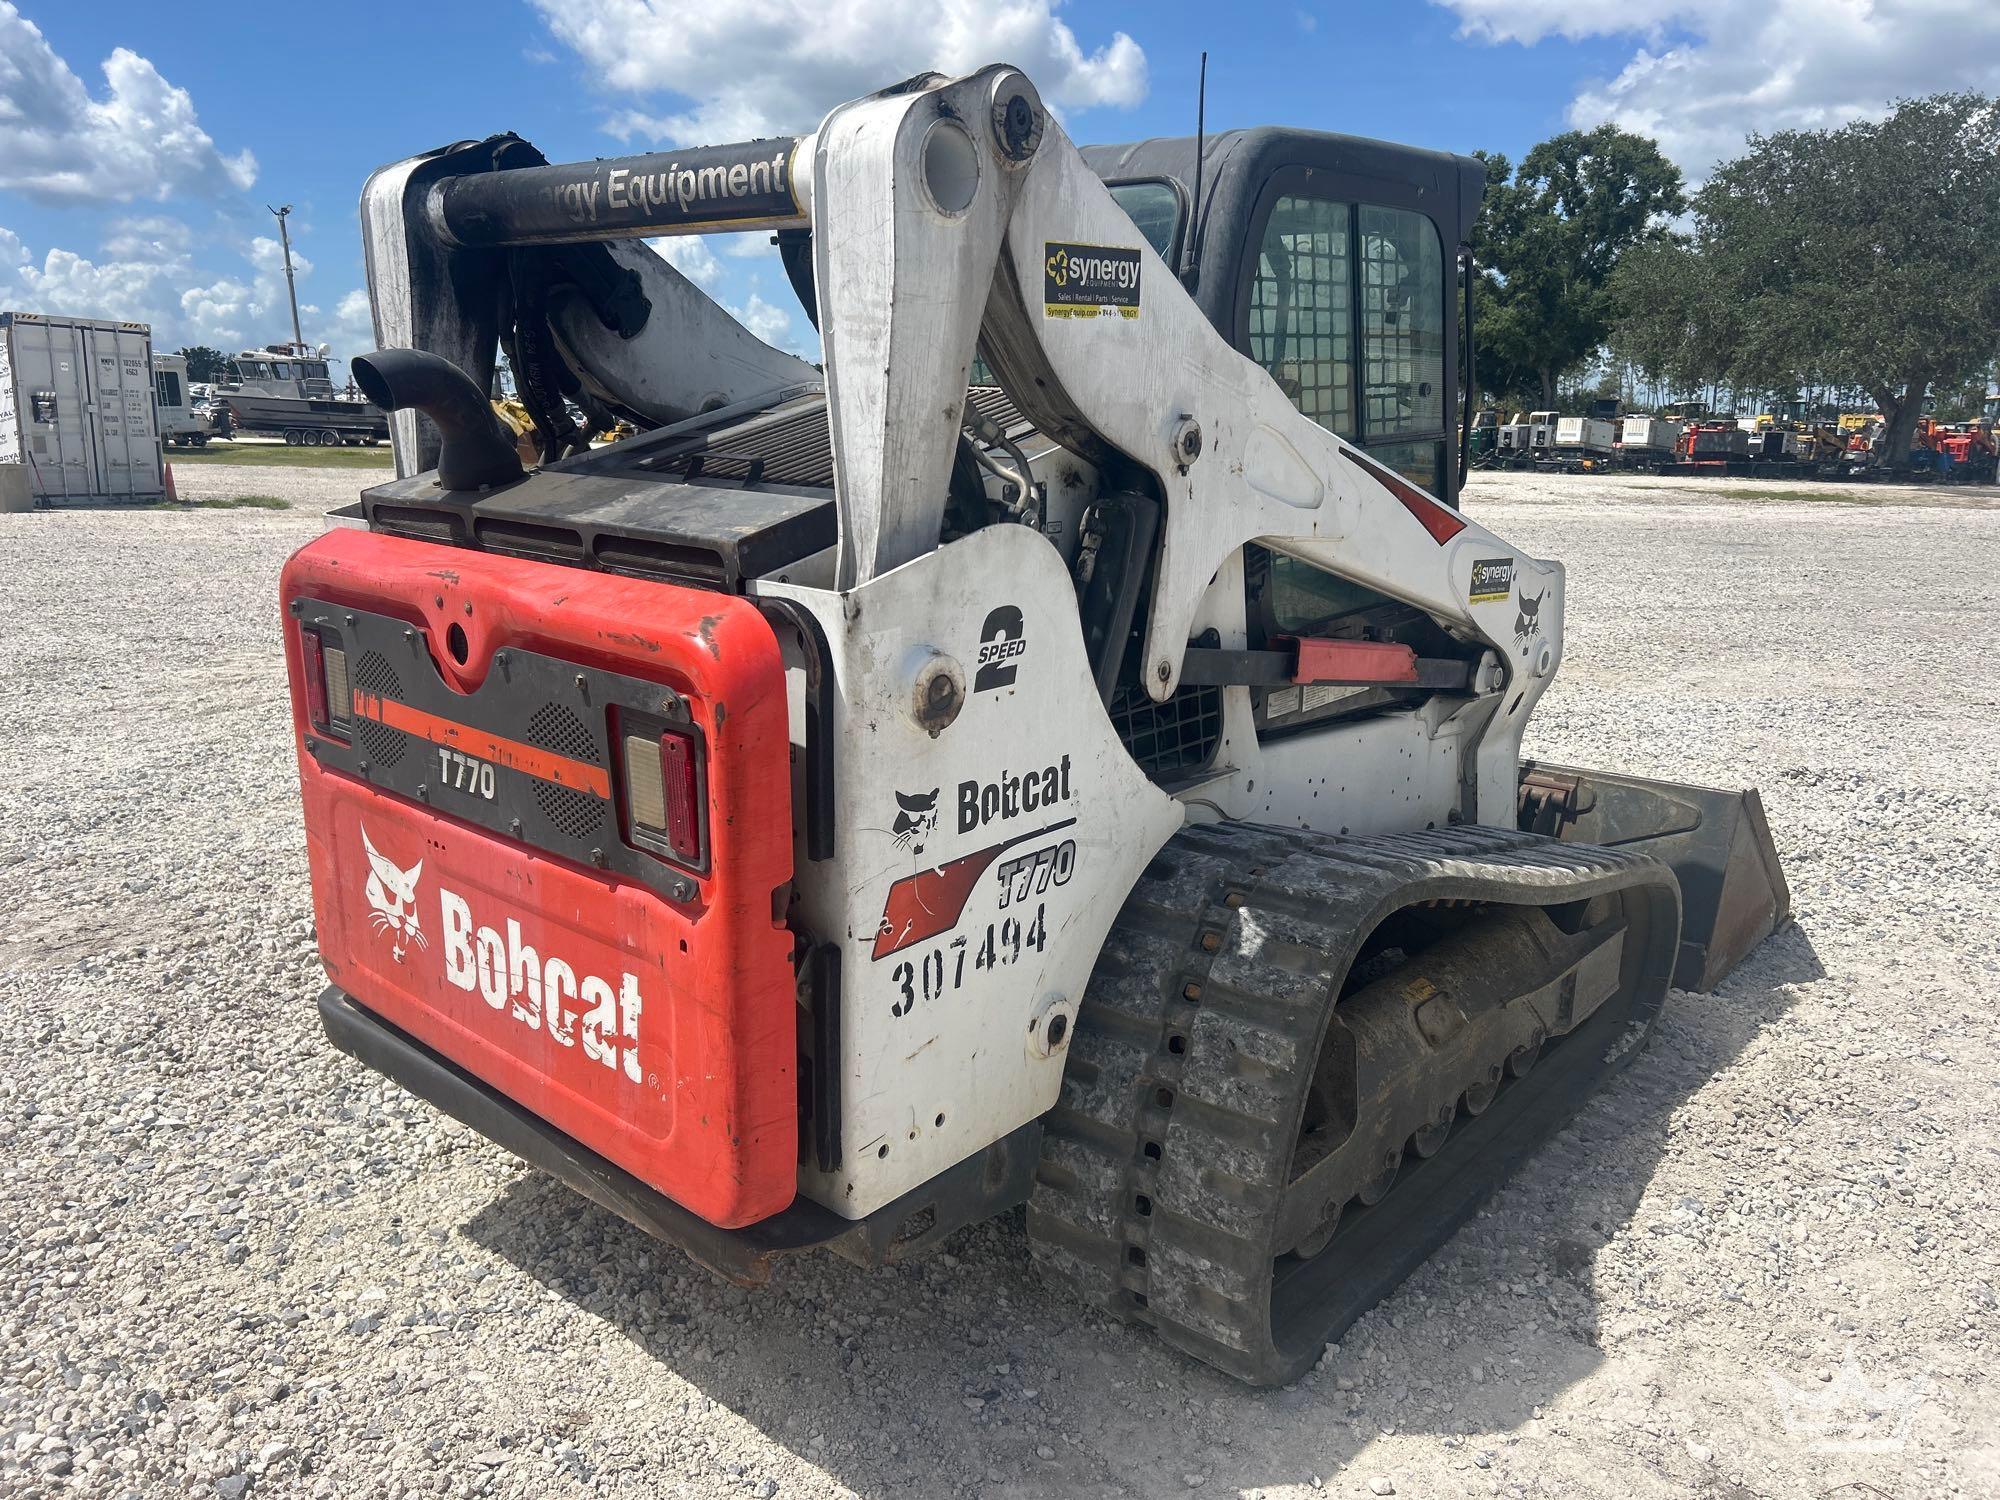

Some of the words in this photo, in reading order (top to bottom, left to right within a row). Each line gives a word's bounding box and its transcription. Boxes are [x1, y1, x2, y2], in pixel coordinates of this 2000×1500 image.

[551, 181, 600, 223] rgy
[607, 152, 786, 216] Equipment
[1057, 292, 1072, 301] Sales
[1075, 293, 1092, 302] Rental
[1095, 294, 1108, 303] Parts
[1111, 295, 1129, 304] Service
[1069, 256, 1140, 289] synergy
[1086, 280, 1118, 288] EQUIPMENT
[1047, 307, 1097, 319] SynergyEquip.com
[1481, 565, 1513, 584] synergy
[974, 605, 1023, 693] 2
[978, 640, 1026, 664] SPEED
[439, 748, 495, 799] T770
[957, 753, 1071, 835] Bobcat
[998, 839, 1076, 909] T770
[891, 902, 1047, 1017] 307494
[440, 887, 643, 1084] Bobcat
